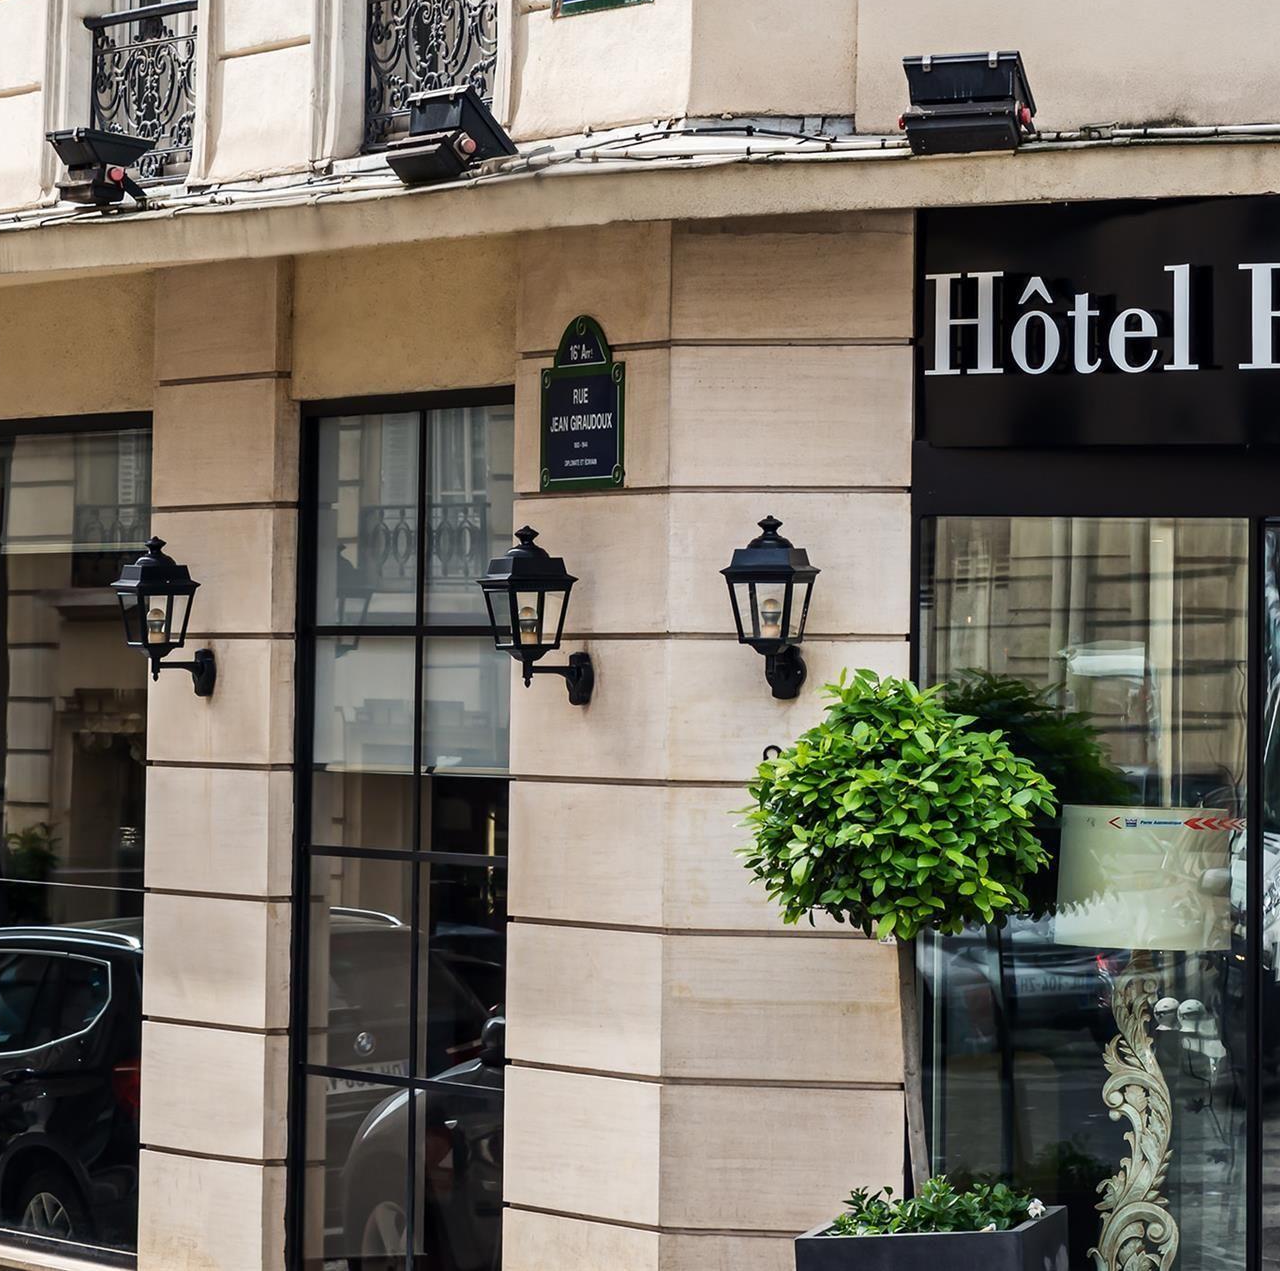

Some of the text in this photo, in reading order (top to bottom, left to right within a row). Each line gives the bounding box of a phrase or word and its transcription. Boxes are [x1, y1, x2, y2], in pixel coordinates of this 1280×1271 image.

[924, 264, 1198, 376] Hôtel
[573, 388, 589, 404] RUE
[550, 413, 613, 433] JEAN GIRAUDOUX
